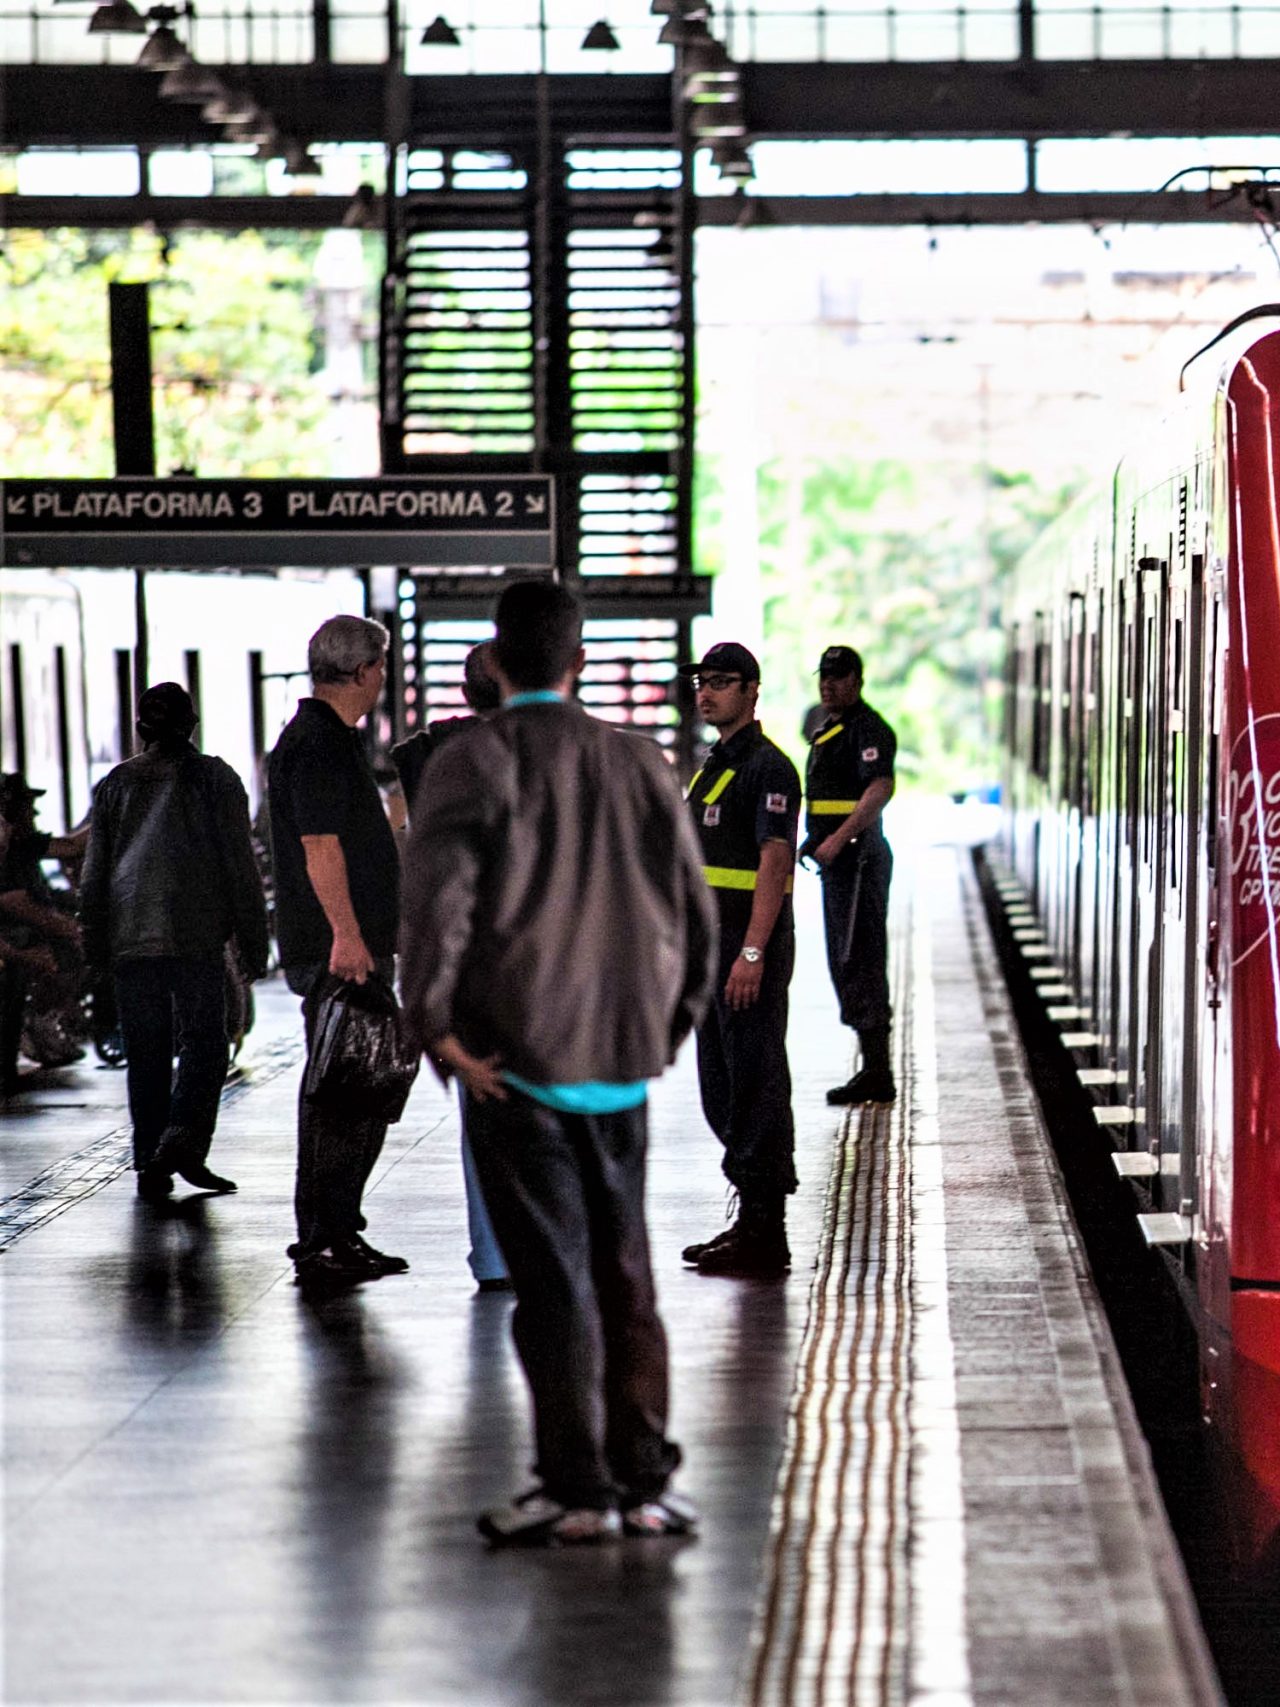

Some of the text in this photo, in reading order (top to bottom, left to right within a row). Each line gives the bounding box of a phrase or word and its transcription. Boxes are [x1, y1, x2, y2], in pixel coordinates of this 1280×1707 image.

[33, 491, 514, 518] PLATAFORMA 3 PLATAFORMA 2
